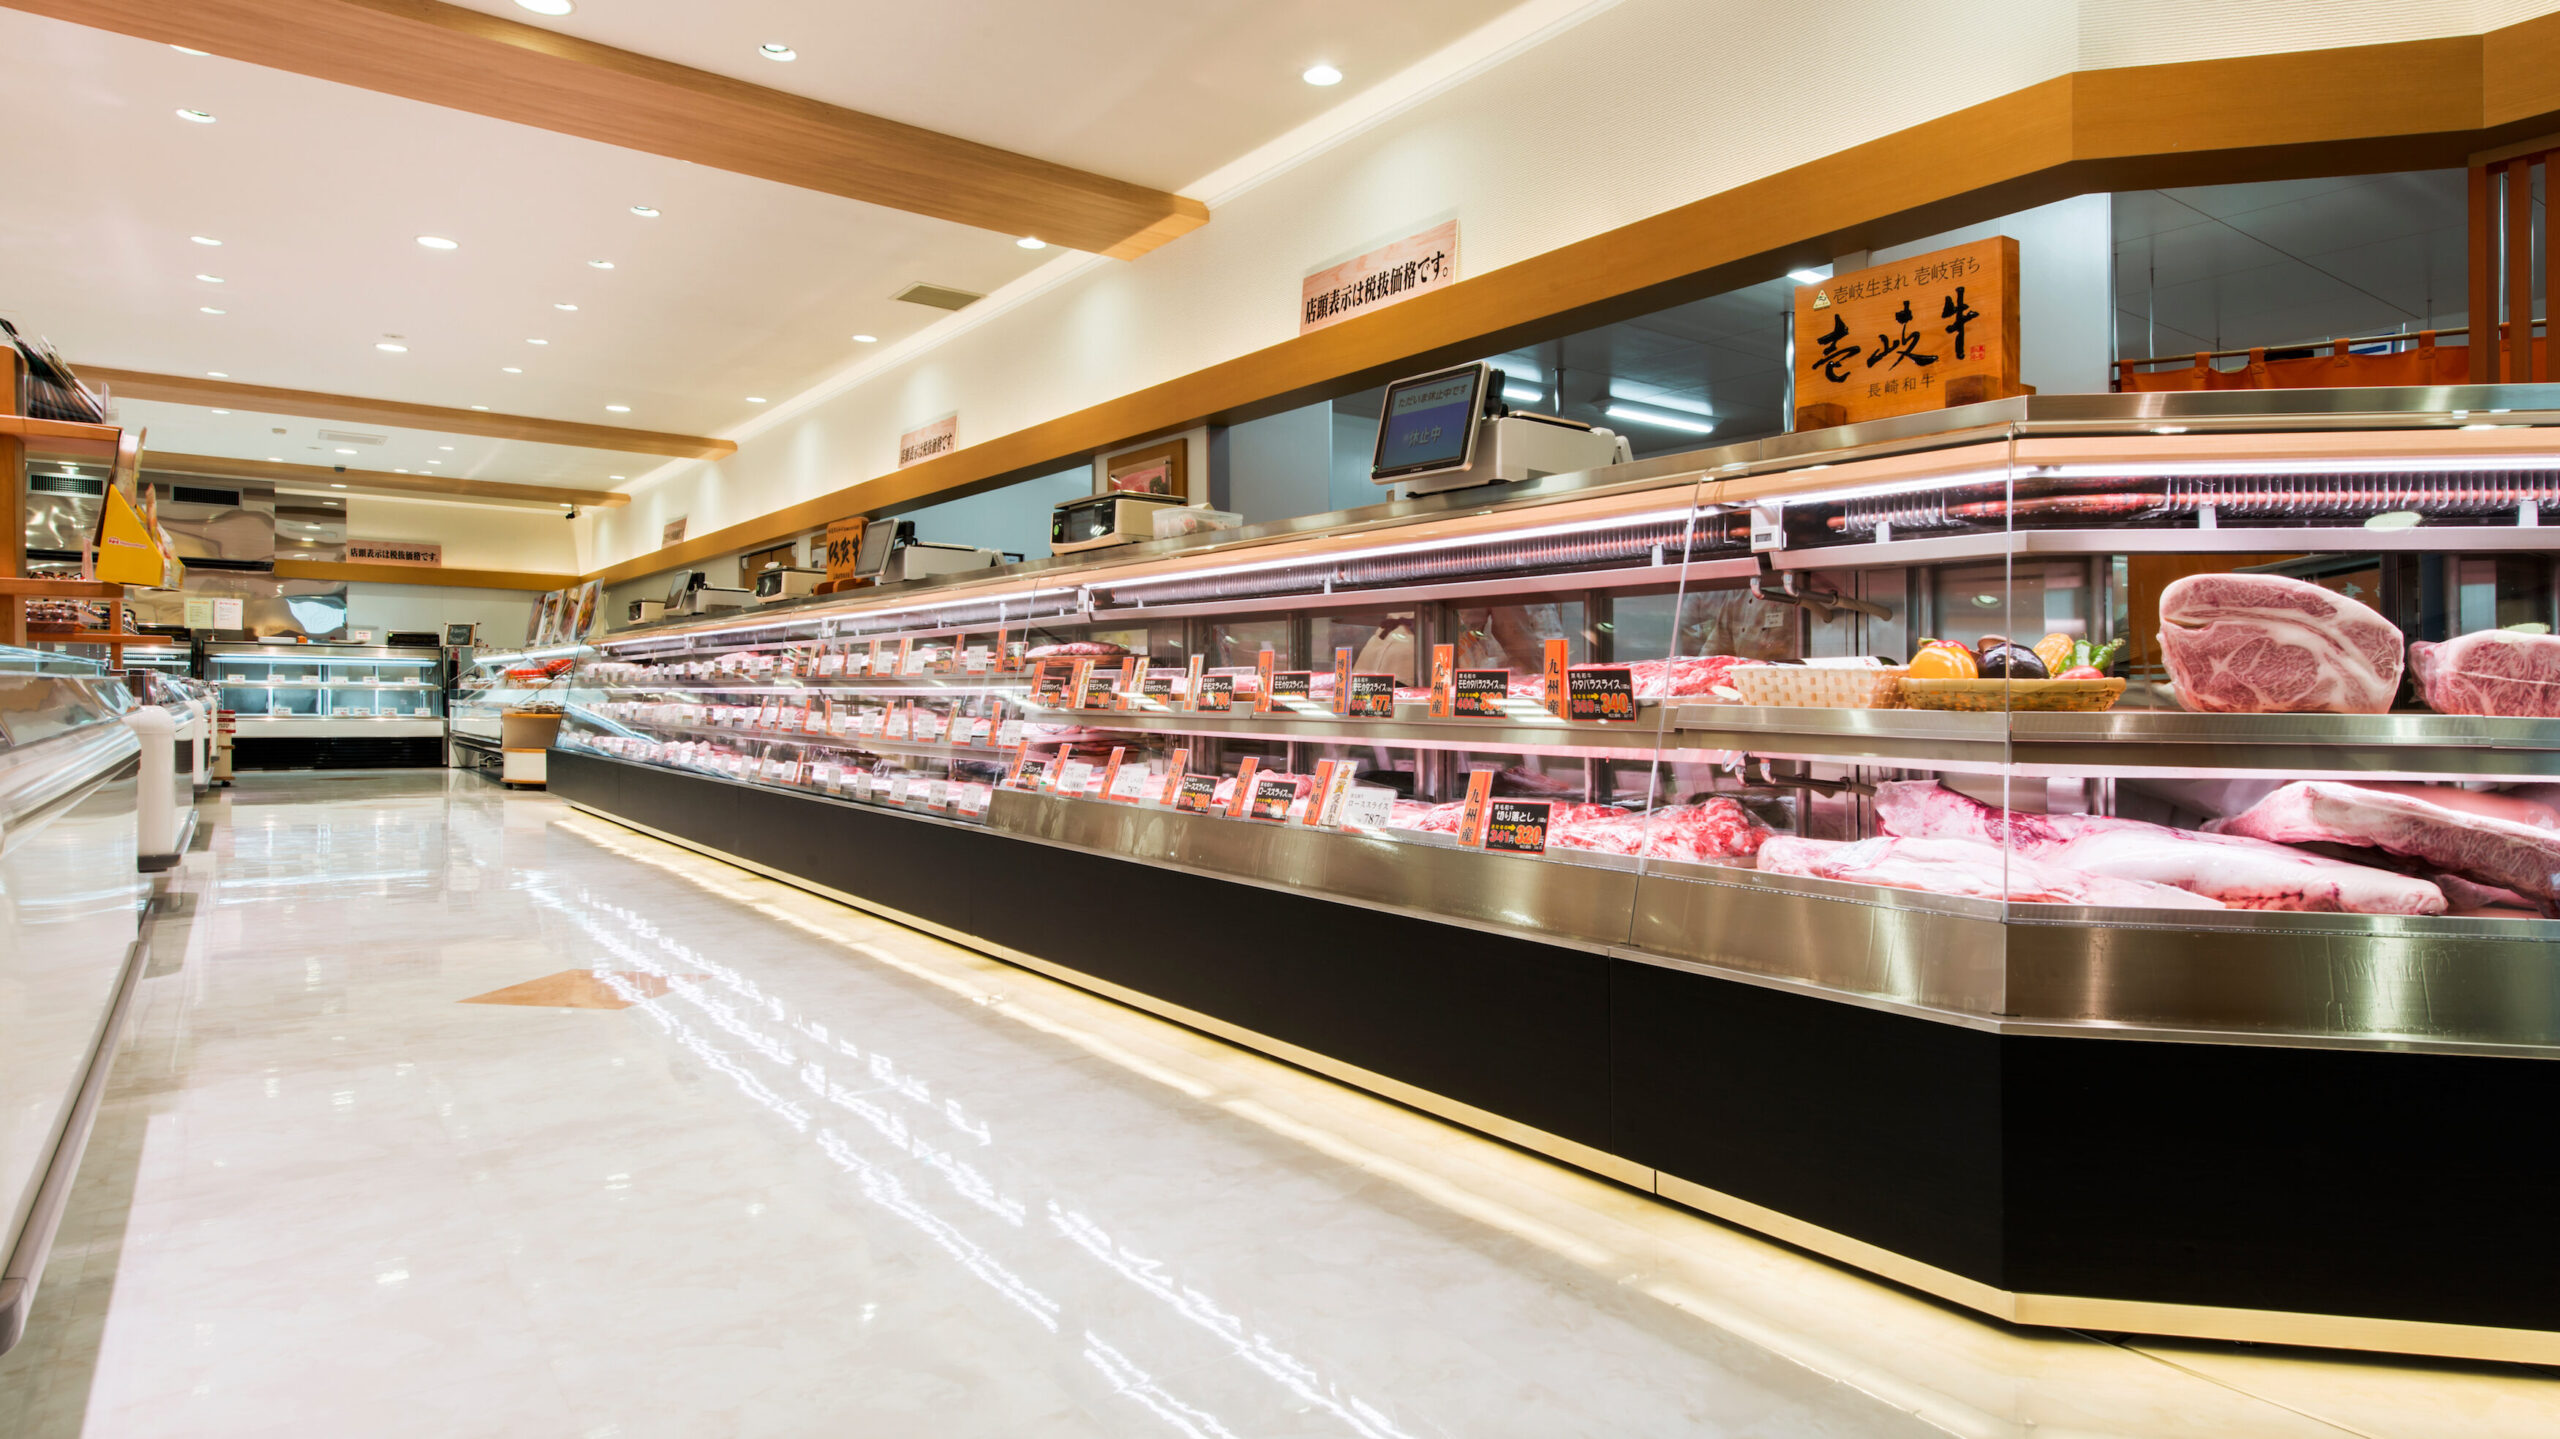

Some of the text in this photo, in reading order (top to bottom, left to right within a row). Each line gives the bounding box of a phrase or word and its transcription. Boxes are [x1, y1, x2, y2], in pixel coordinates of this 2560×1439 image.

[1305, 251, 1449, 325] 店頭表示は税抜価格です。
[1833, 256, 1981, 304] 壱岐生まれ 壱岐育ち
[1812, 286, 1980, 383] 壱岐牛
[1867, 373, 1936, 399] 長崎和牛
[1431, 661, 1445, 714] 九州産
[1547, 658, 1560, 716] 九州産
[1571, 679, 1621, 690] カタバラスライス
[1600, 693, 1633, 714] 340円
[1461, 788, 1480, 842] 九州産
[1489, 824, 1544, 846] 341円 320円
[1496, 810, 1535, 823] 切り落とし
